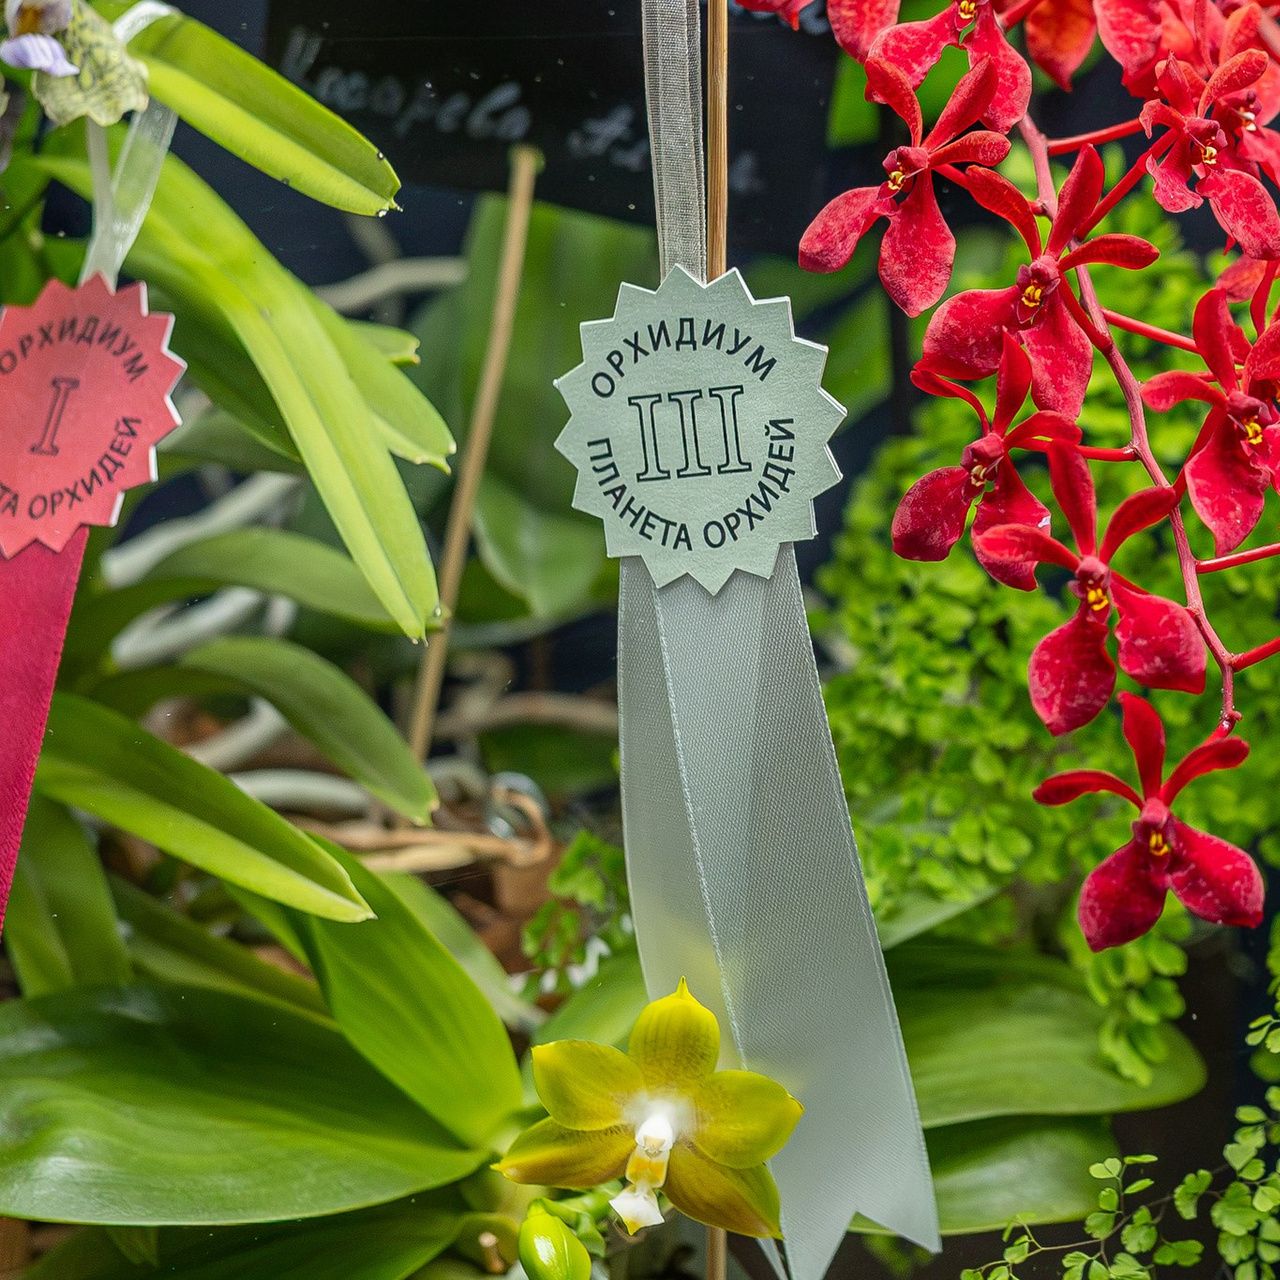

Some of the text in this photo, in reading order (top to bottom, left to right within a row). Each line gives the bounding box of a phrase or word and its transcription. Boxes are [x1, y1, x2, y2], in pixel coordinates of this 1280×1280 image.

[0, 315, 148, 383] ОРХИДИУМ
[591, 317, 777, 398] ОРХИДИУМ
[29, 376, 80, 456] I
[628, 385, 752, 482] III
[28, 416, 142, 519] ОРХИДЕЙ
[587, 417, 796, 551] ПЛАНЕТА ОРХИДЕЙ
